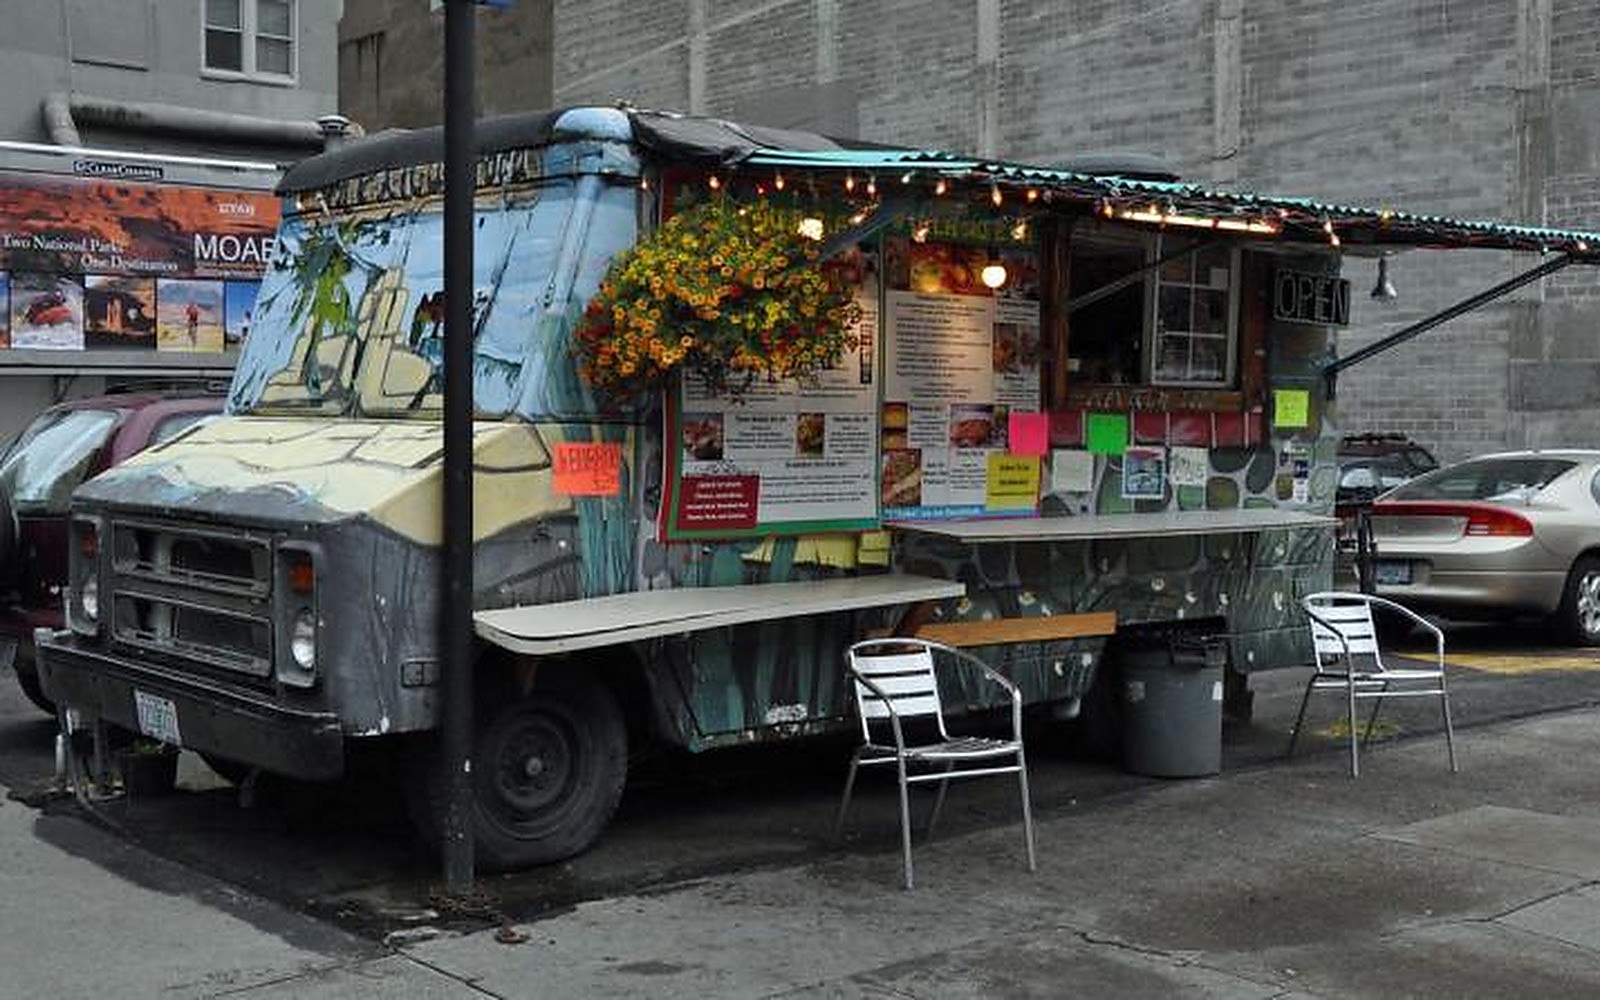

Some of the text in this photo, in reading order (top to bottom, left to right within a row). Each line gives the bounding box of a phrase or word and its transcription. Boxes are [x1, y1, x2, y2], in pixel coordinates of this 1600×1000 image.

[3, 233, 31, 249] Two
[34, 235, 86, 251] National
[1279, 275, 1350, 325] OPEN
